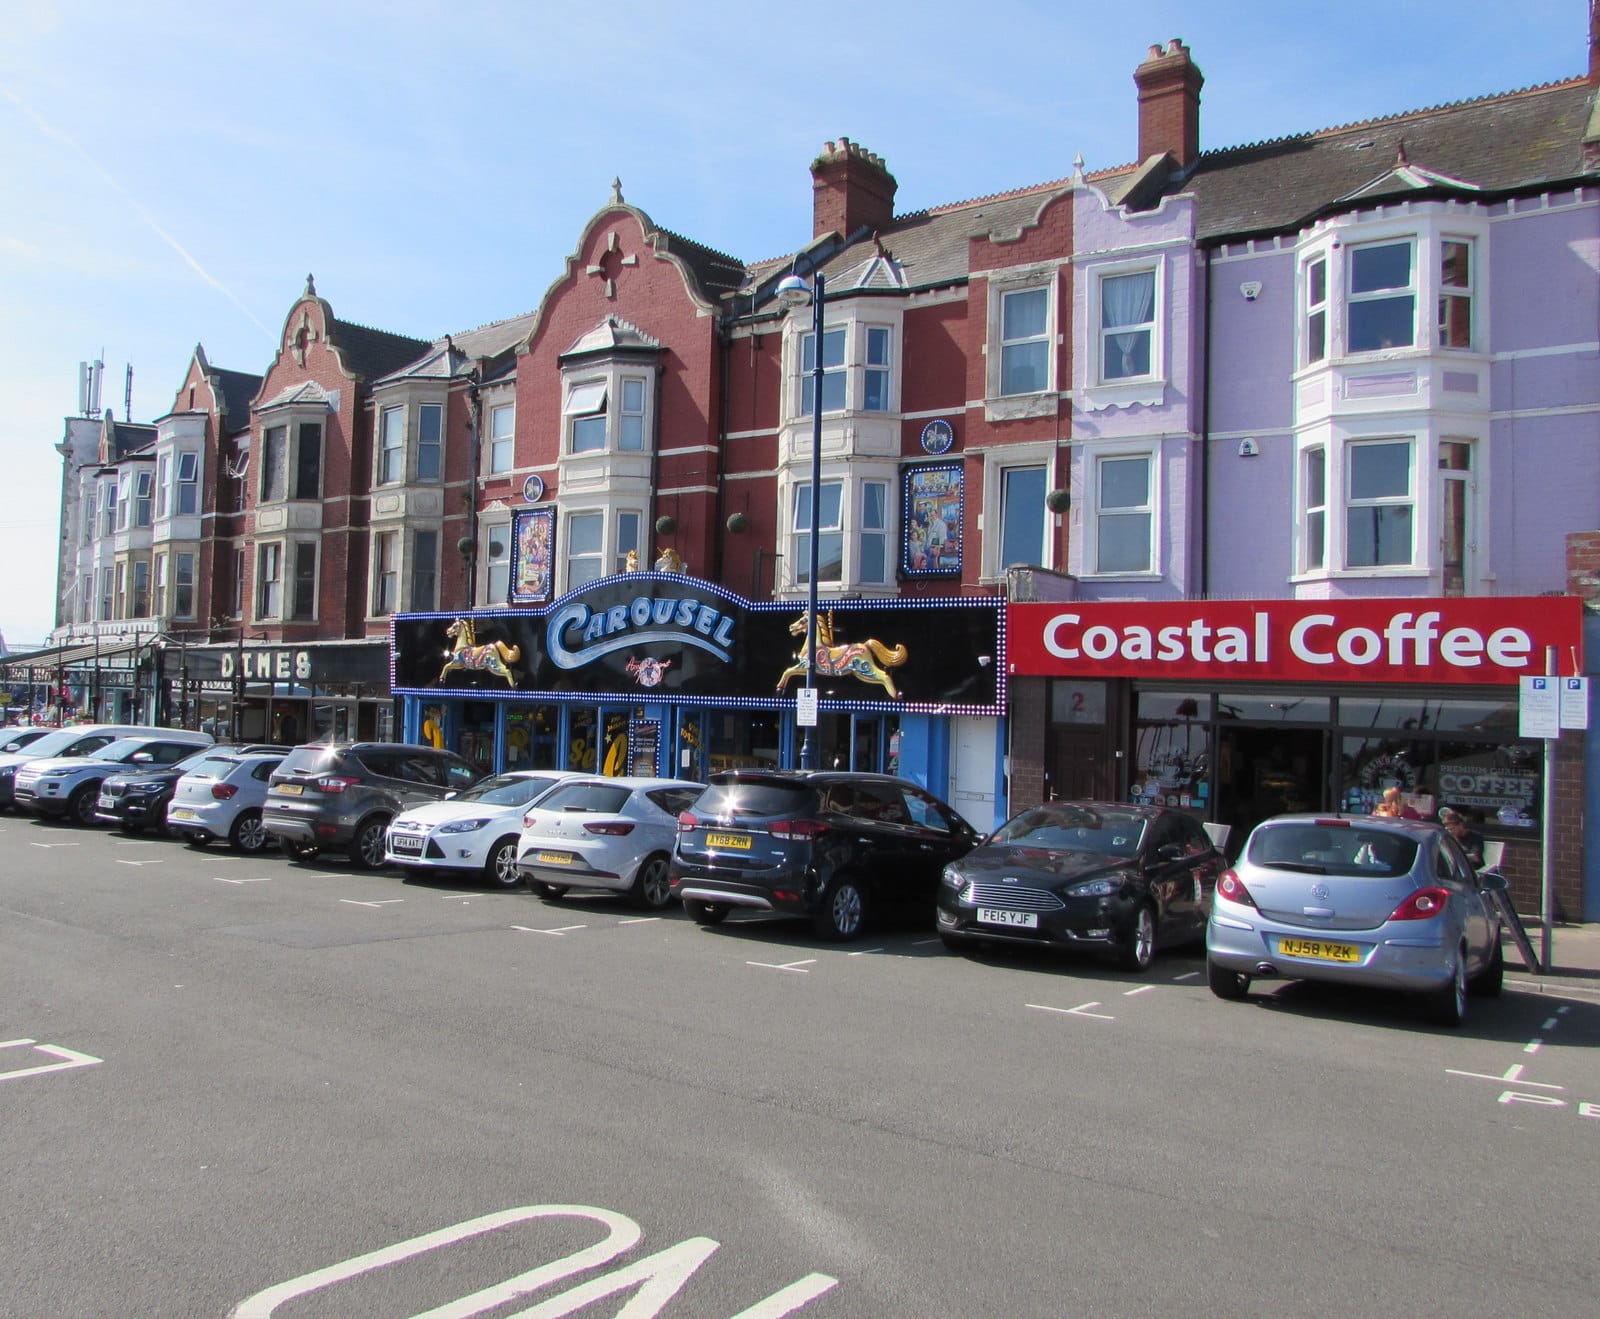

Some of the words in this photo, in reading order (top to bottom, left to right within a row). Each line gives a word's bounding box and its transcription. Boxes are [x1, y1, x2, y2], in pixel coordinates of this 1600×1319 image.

[546, 596, 736, 670] CAROUSEL
[1042, 612, 1269, 663] Coastal
[1289, 611, 1532, 668] Coffee
[221, 651, 311, 679] DIMES
[1071, 691, 1085, 712] 2
[1439, 774, 1534, 795] COFFEE
[983, 909, 1006, 922] FE15
[1009, 911, 1030, 924] YJF
[1284, 939, 1320, 955] NJ58
[1324, 943, 1351, 959] YZK
